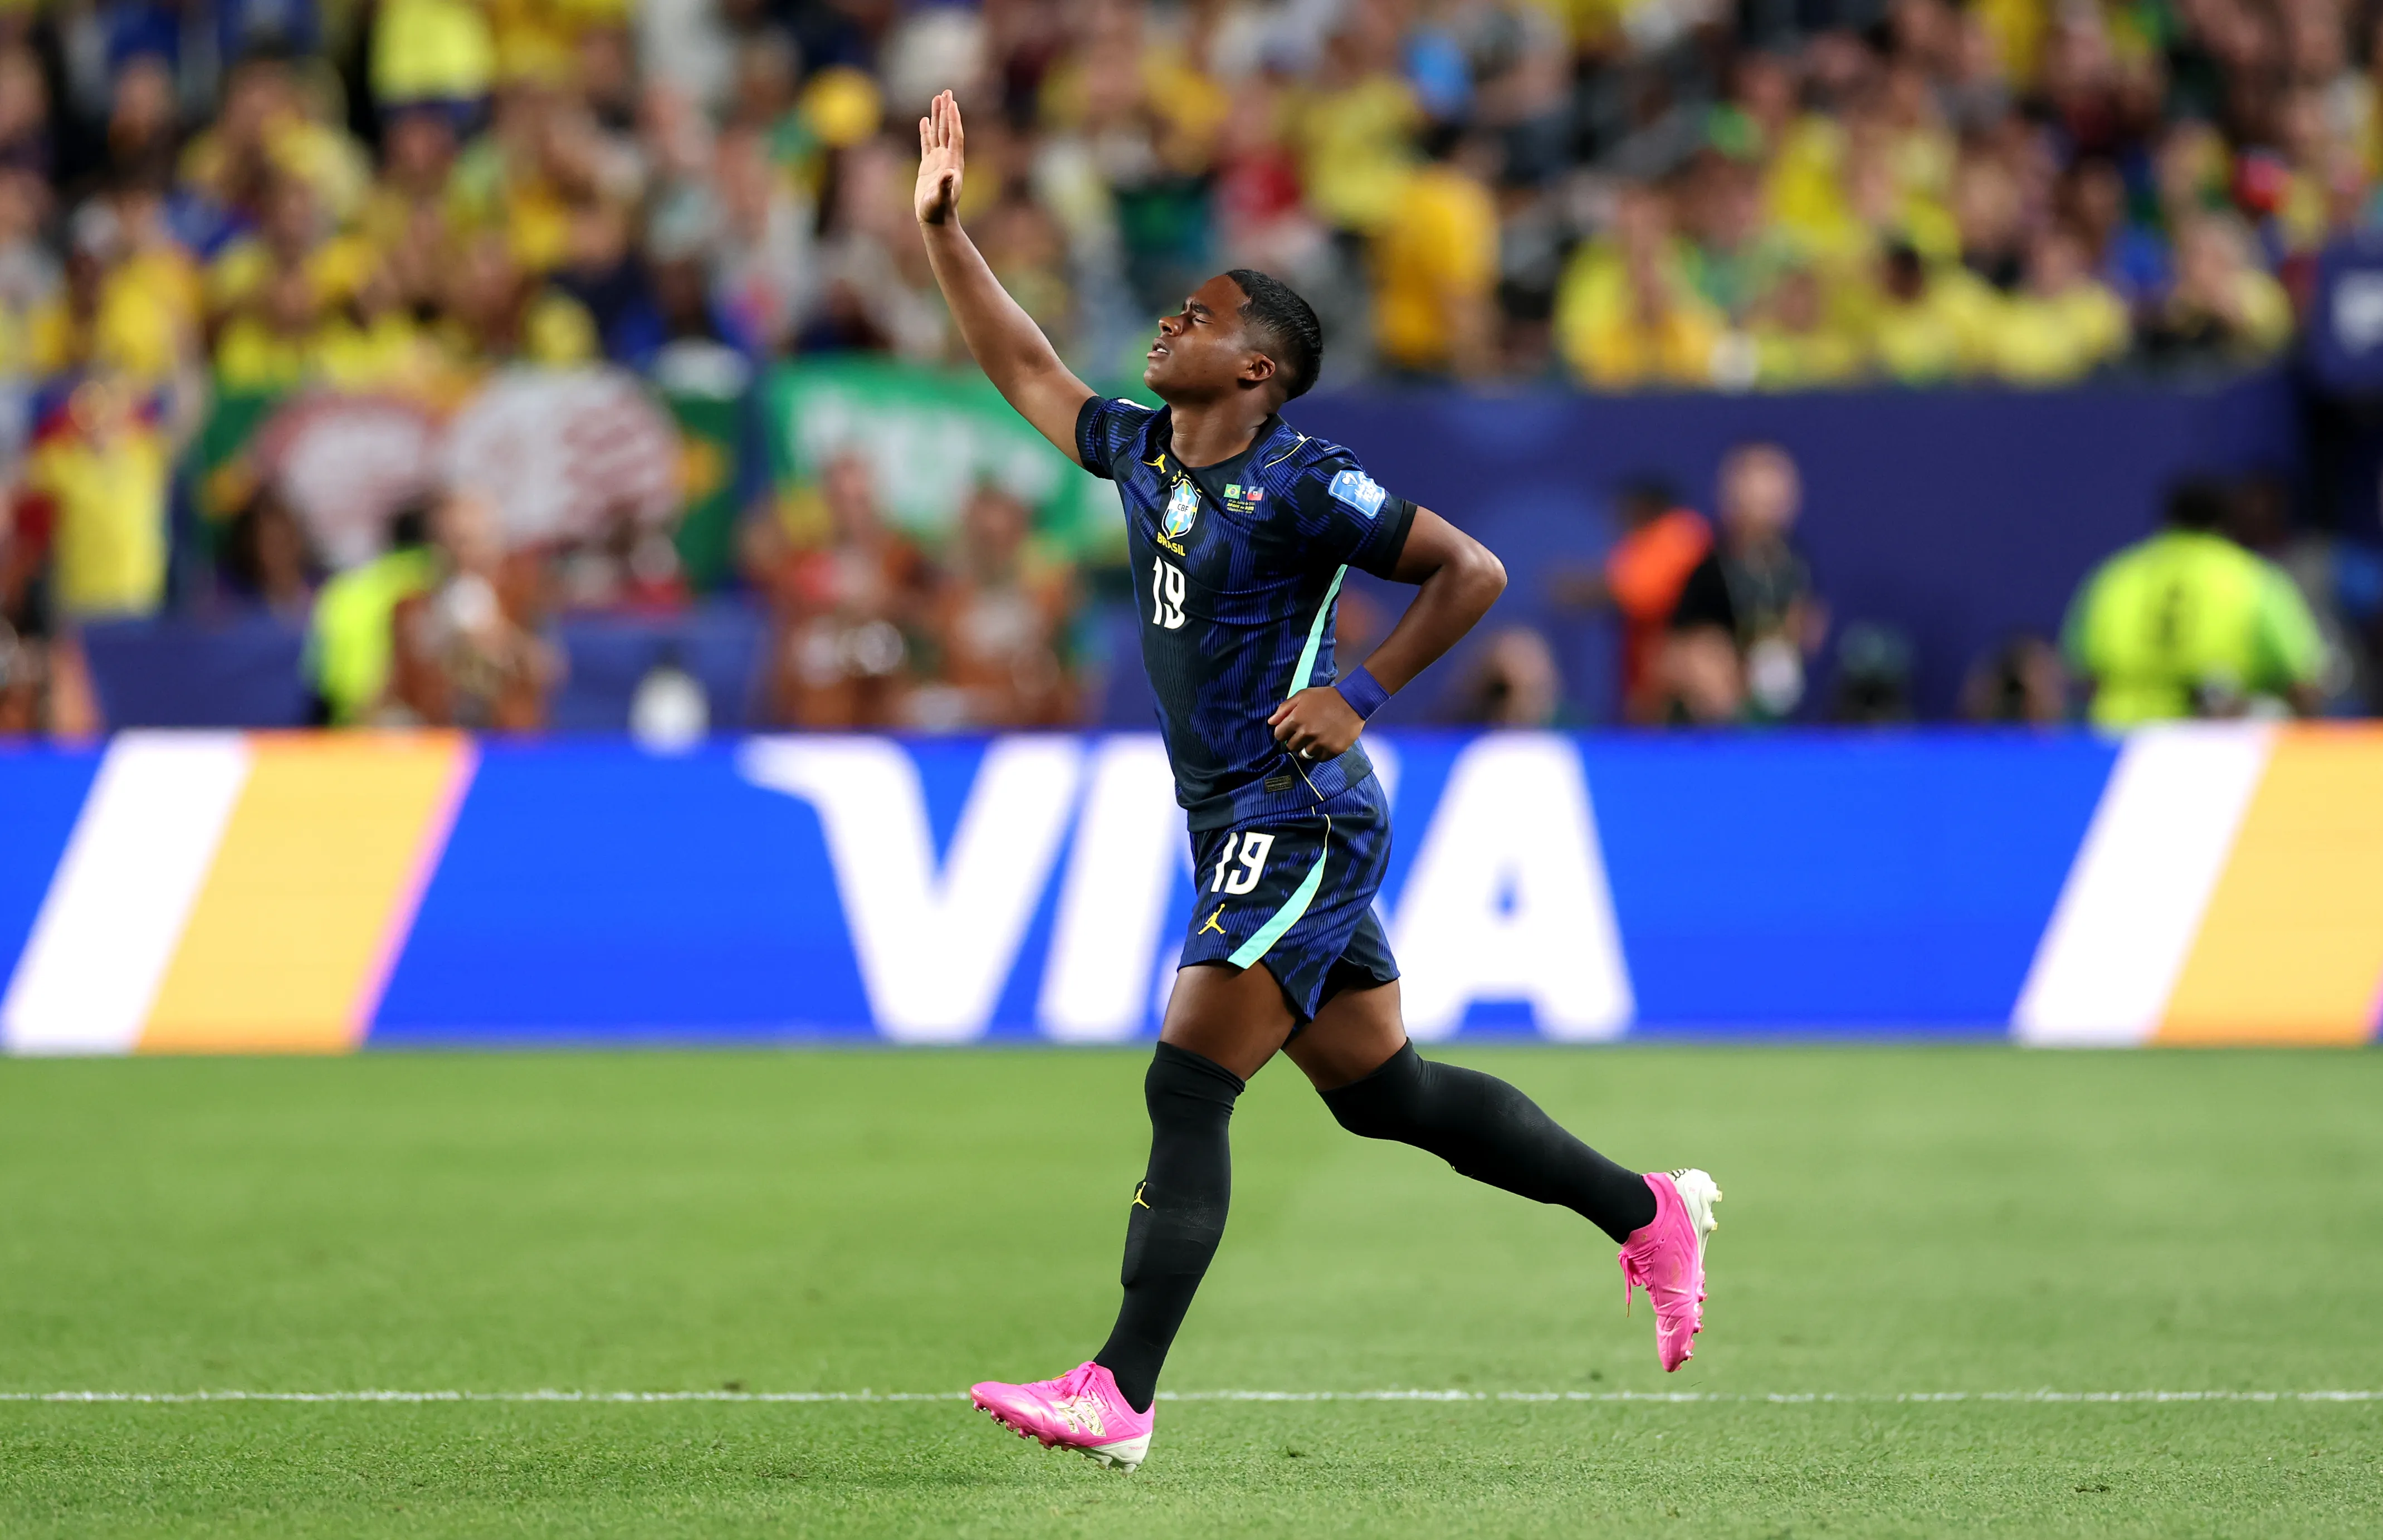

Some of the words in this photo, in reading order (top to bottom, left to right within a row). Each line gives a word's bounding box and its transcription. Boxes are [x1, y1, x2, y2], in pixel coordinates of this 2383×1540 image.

[1178, 503, 1189, 512] CBF
[1157, 531, 1185, 556] BRASIL
[1153, 556, 1185, 629] 19
[738, 736, 1637, 1038] VIA
[1210, 832, 1276, 895] 19
